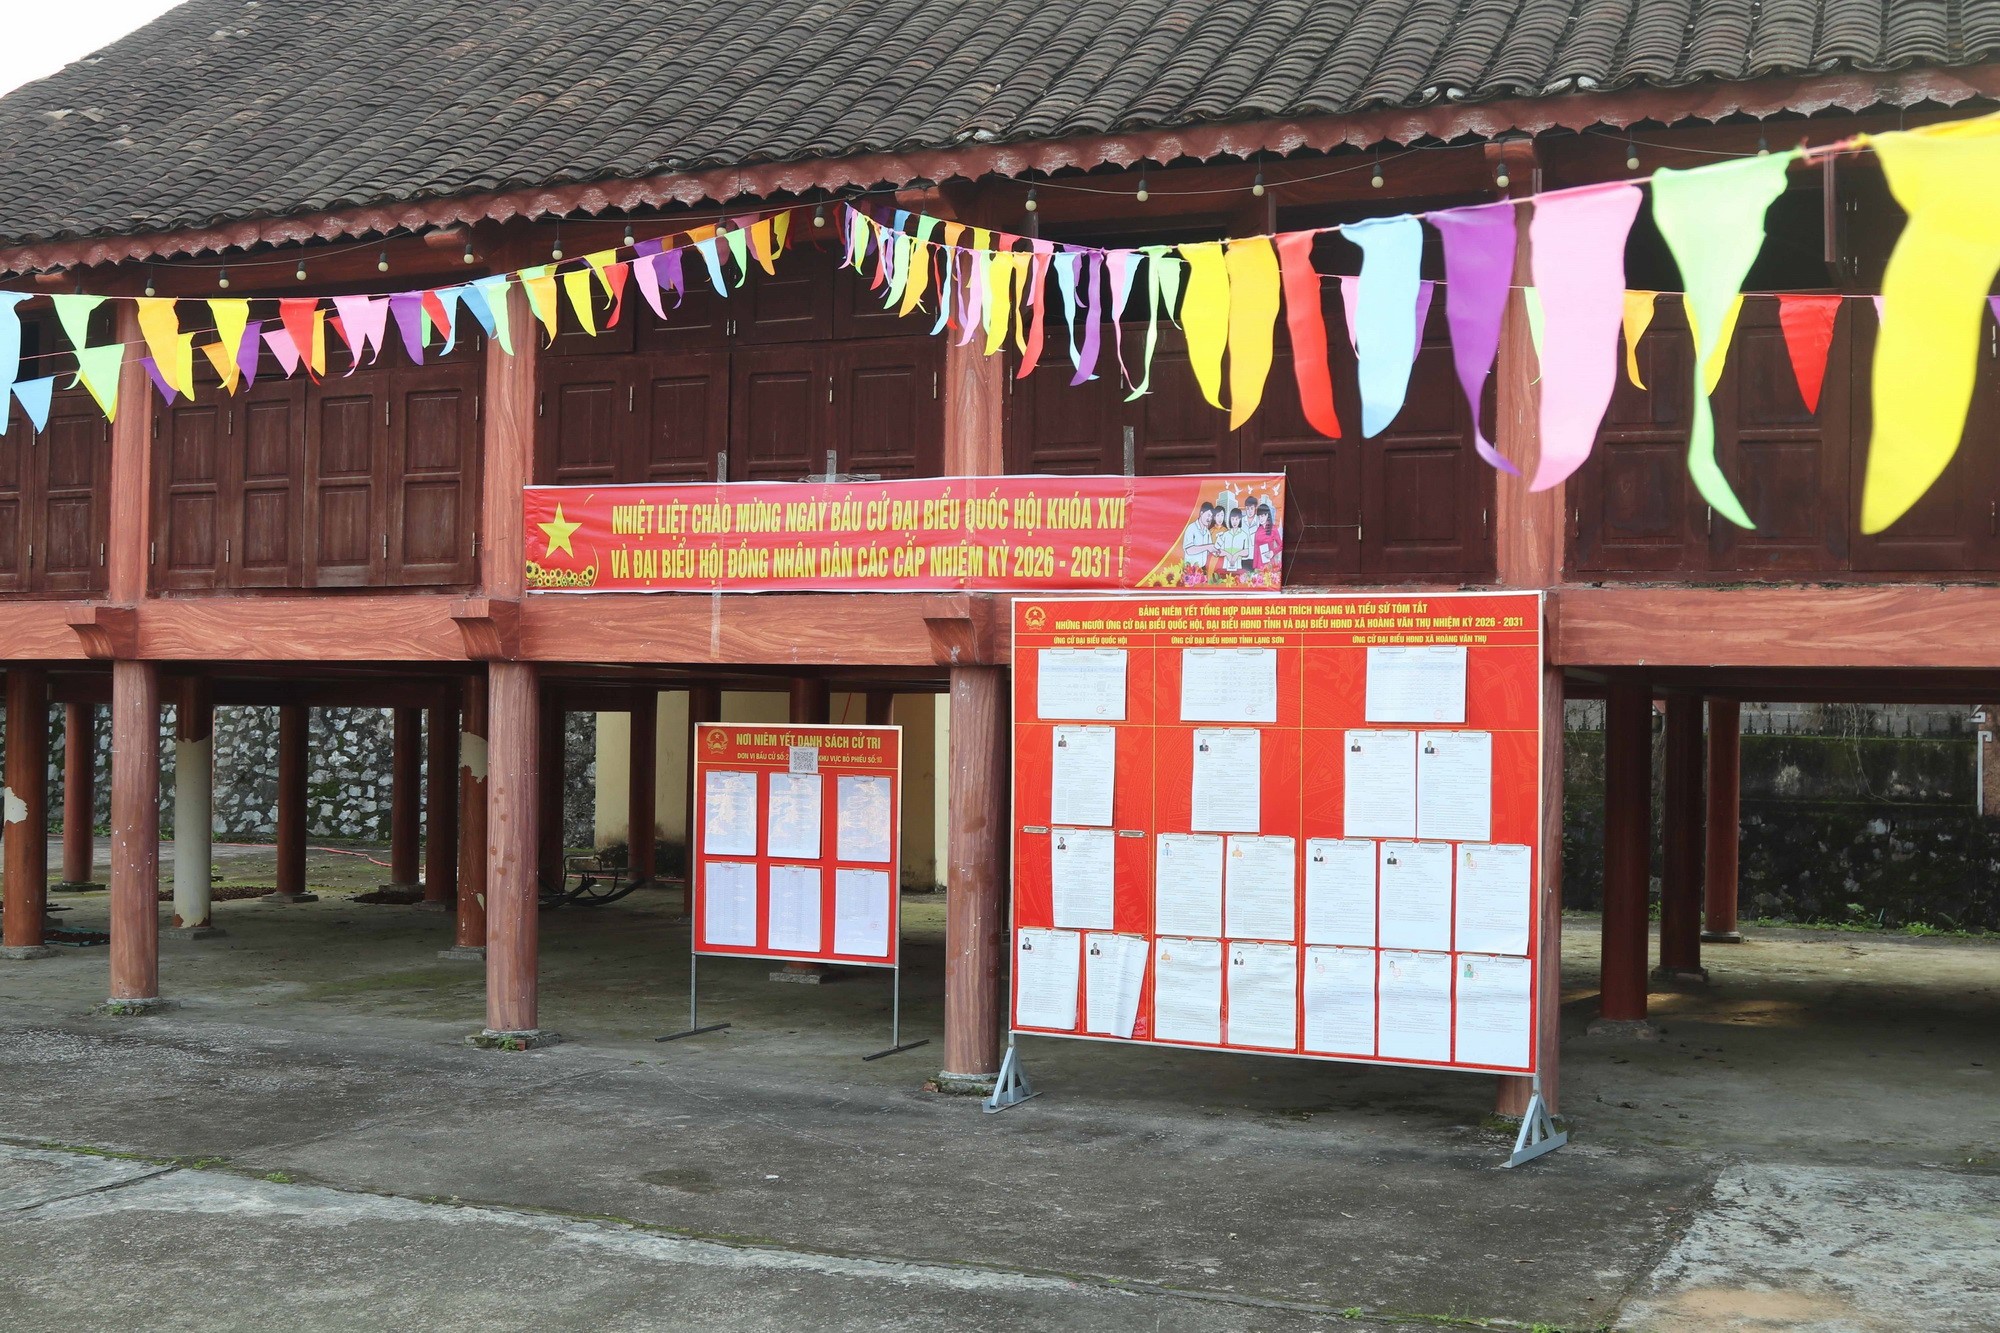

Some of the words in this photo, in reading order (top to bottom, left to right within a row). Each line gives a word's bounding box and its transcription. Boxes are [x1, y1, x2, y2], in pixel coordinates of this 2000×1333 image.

[612, 499, 654, 541] NHIỆT
[658, 498, 688, 540] LIỆT
[691, 498, 731, 534] CHÀO
[735, 497, 781, 533] MỪNG
[785, 496, 828, 532] NGÀY
[831, 491, 862, 532] BẦU
[866, 490, 890, 531] CỬ
[892, 499, 918, 537] ĐẠI
[923, 486, 960, 530] BIỂU
[965, 487, 1009, 533] QUỐC
[1013, 491, 1042, 536] HỘI
[1046, 491, 1092, 530] KHÓA
[1097, 498, 1126, 529] XVI
[611, 544, 630, 579] VÀ
[633, 549, 657, 585] ĐẠI
[662, 537, 695, 579] BIỂU
[699, 543, 723, 585] HỘI
[727, 538, 769, 578] ĐỒNG
[773, 542, 816, 578] NHÂN
[820, 541, 853, 577] DÂN
[857, 541, 889, 578] CÁC
[893, 536, 925, 578] CẤP
[930, 539, 983, 584] NHIỆM
[988, 539, 1010, 577] KỲ
[1014, 546, 1054, 578] 2026
[1070, 546, 1110, 578] 2031
[1118, 546, 1124, 577] !
[1138, 604, 1160, 617] BẢNG
[1161, 605, 1182, 616] NIÊM
[1184, 603, 1198, 616] YẾT
[1200, 603, 1220, 616] TỔNG
[1222, 605, 1239, 617] HỢP
[1241, 606, 1262, 616] DANH
[1264, 604, 1286, 616] SÁCH
[1288, 604, 1312, 615] TRÍCH
[1314, 605, 1343, 615] NGANG
[1345, 603, 1356, 614] VÀ
[1358, 601, 1376, 614] TIỂU
[1378, 601, 1391, 614] SỬ
[1392, 602, 1410, 613] TÓM
[1055, 619, 1080, 630] NHỮNG
[1082, 619, 1104, 630] NGƯỜI
[1106, 619, 1121, 630] ỨNG
[1123, 618, 1134, 630] CỬ
[1134, 620, 1147, 631] ĐẠI
[1149, 617, 1166, 630] BIỂU
[1168, 618, 1188, 629] QUỐC
[1189, 619, 1204, 631] HỘI,
[1206, 620, 1219, 631] ĐẠI
[1221, 617, 1239, 629] BIỂU
[1241, 620, 1261, 629] HĐND
[1263, 617, 1281, 629] TỈNH
[1283, 618, 1293, 629] VÀ
[1295, 619, 1308, 631] ĐẠI
[1310, 616, 1329, 629] BIỂU
[1331, 619, 1352, 629] HĐND
[1354, 617, 1365, 628] XÃ
[1367, 617, 1395, 628] HOÀNG
[1397, 617, 1413, 627] VĂN
[1415, 617, 1431, 629] THỤ
[1433, 616, 1460, 629] NHIỆM
[1462, 615, 1473, 627] KỲ
[1475, 617, 1495, 627] 2026
[1503, 617, 1523, 627] 2031
[736, 733, 751, 746] NƠI
[754, 732, 777, 747] NIÊM
[780, 730, 794, 747] YẾT
[797, 735, 822, 748] DANH
[825, 733, 849, 748] SÁCH
[851, 732, 865, 748] CỬ
[866, 736, 881, 749] TRI
